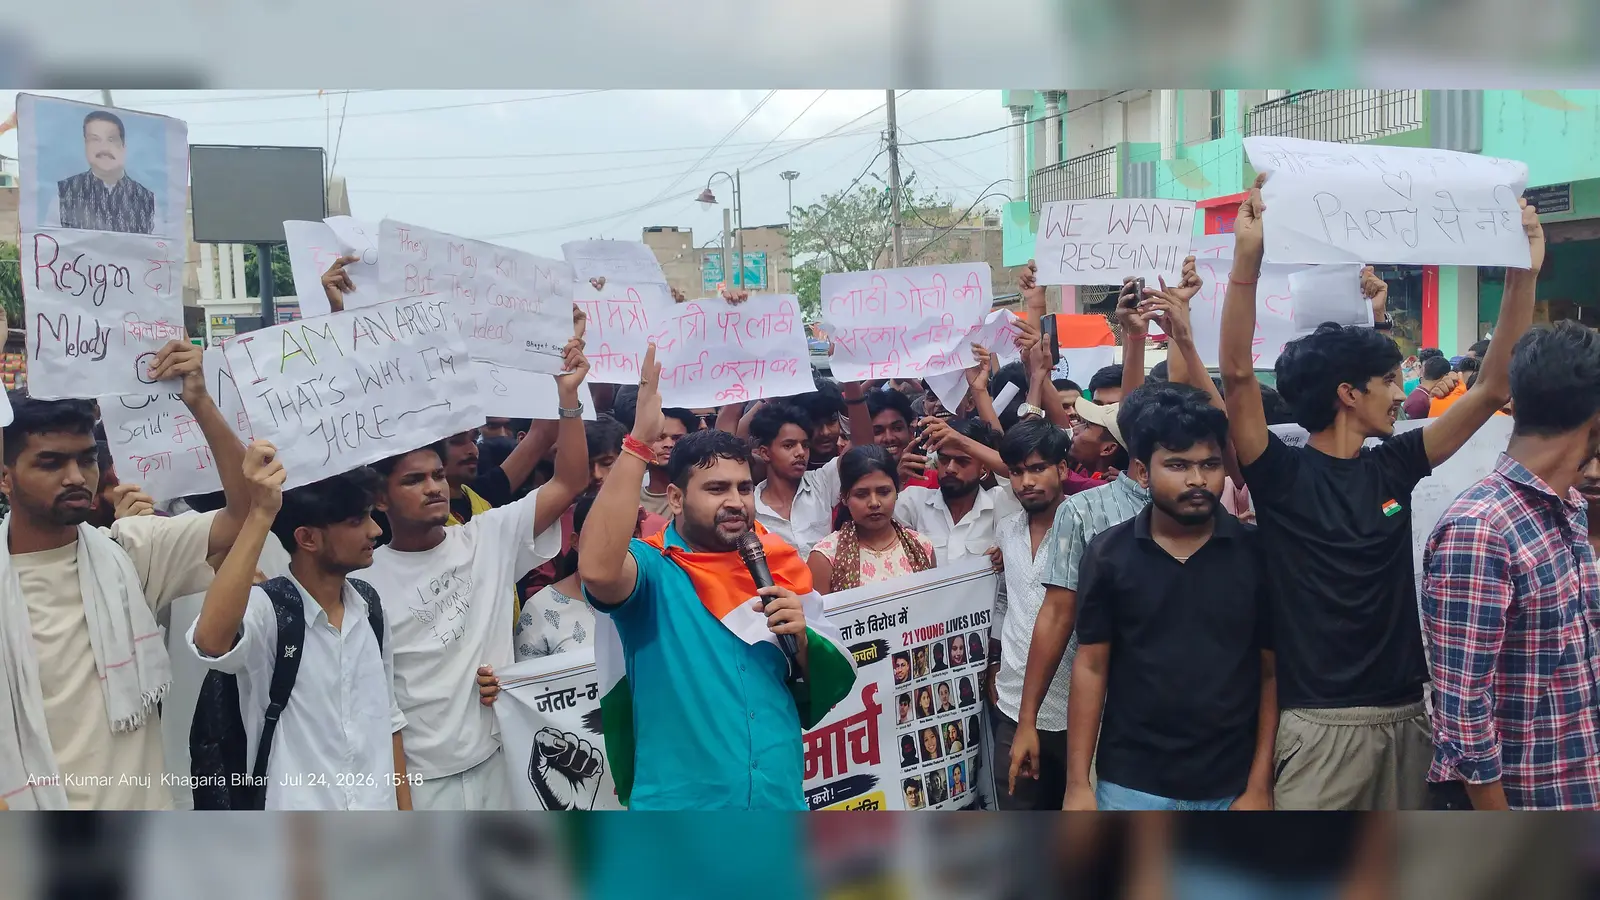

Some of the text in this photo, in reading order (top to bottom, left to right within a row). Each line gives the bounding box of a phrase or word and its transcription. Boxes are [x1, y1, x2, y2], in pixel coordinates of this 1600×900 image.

[1046, 203, 1087, 239] WE
[1108, 203, 1190, 235] WANT
[397, 227, 563, 296] They May Kill Me
[404, 263, 435, 293] But
[444, 273, 478, 305] They
[237, 336, 268, 385] I
[280, 322, 344, 374] AM
[352, 312, 397, 351] AN
[394, 300, 450, 338] ARTIST
[717, 312, 744, 348] पर
[256, 373, 346, 428] THAT'S
[308, 404, 396, 466] HERE
[854, 619, 866, 637] के
[867, 612, 896, 634] विरोध
[897, 606, 909, 625] में
[902, 609, 991, 646] 21 YOUNG LIVES LOST
